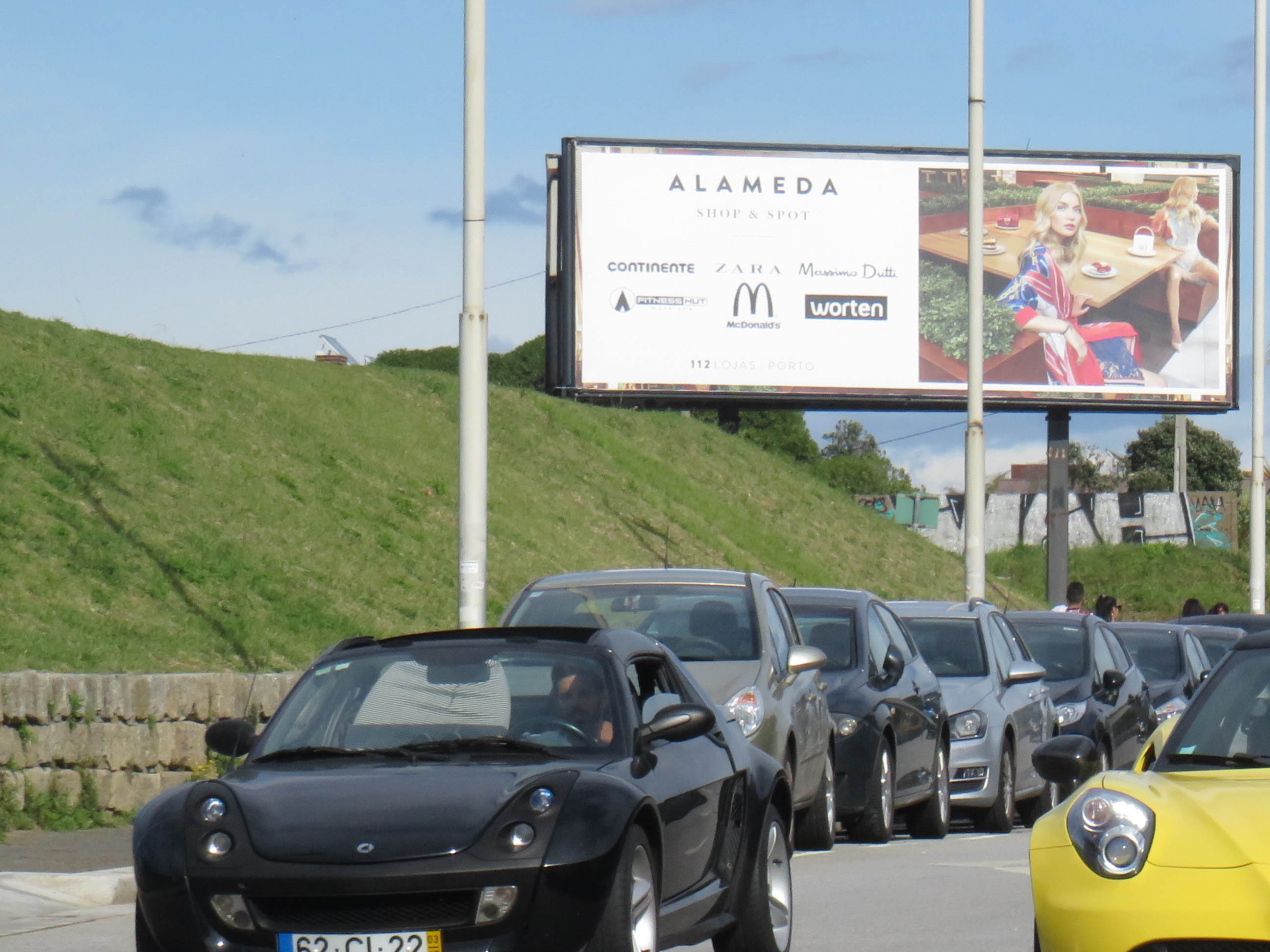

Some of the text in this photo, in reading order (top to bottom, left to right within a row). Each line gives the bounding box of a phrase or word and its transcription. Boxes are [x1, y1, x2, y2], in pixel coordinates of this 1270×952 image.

[668, 173, 839, 196] ALAMEDA
[696, 208, 810, 221] SHOP & SPOT
[607, 261, 695, 274] CONTINENTE
[715, 263, 781, 275] ZARA
[798, 262, 899, 279] Massimo Dutti
[638, 297, 682, 305] FITNESS
[810, 299, 884, 318] worten
[726, 321, 781, 330] McDonald's
[691, 360, 815, 371] 112 LOJAS PORTO
[427, 935, 439, 944] 03
